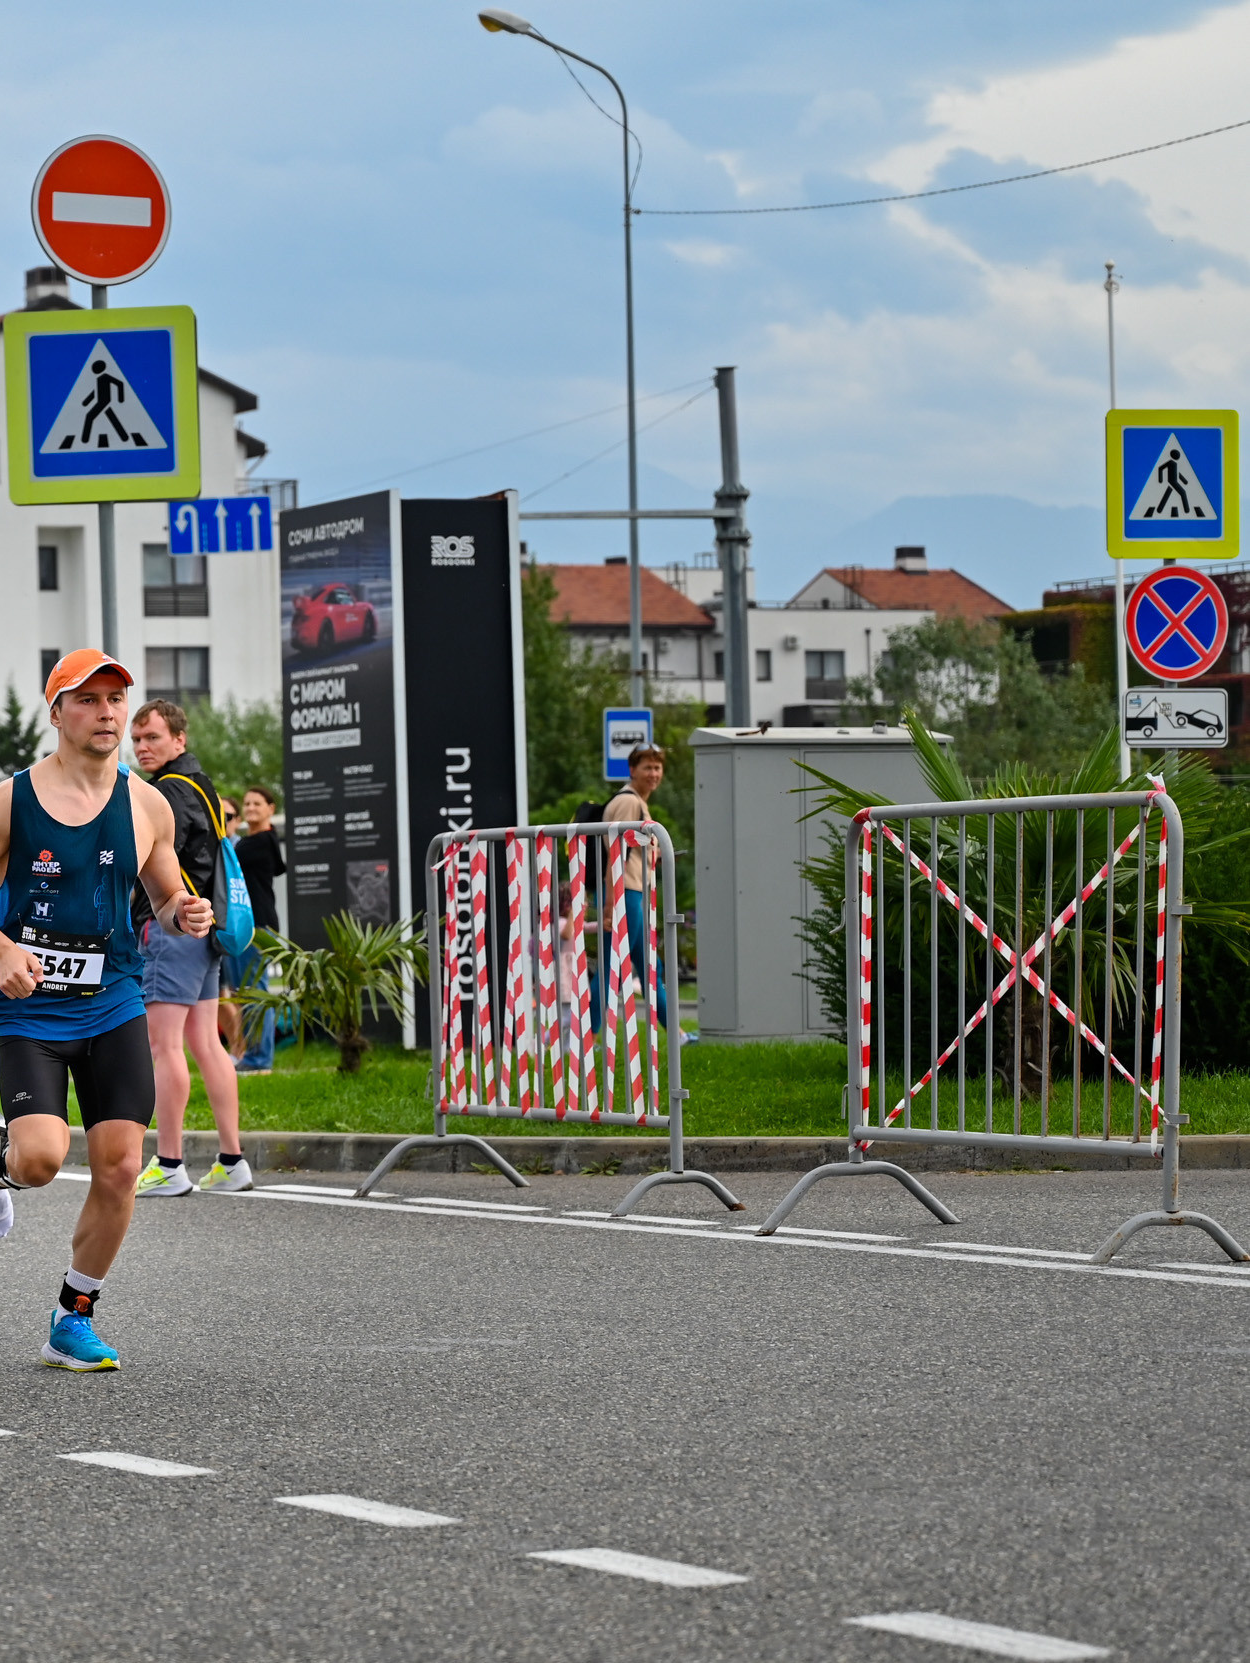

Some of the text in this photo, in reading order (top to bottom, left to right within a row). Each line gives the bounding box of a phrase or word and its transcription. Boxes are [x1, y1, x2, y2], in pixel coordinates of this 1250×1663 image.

[288, 517, 364, 546] СОЧИ АВТОДРОМ
[430, 535, 475, 558] ROS
[290, 677, 346, 705] С МИРОМ
[290, 702, 361, 731] ФОРМУЛЫ 1
[21, 931, 36, 941] STAR
[41, 982, 68, 992] ANDREY
